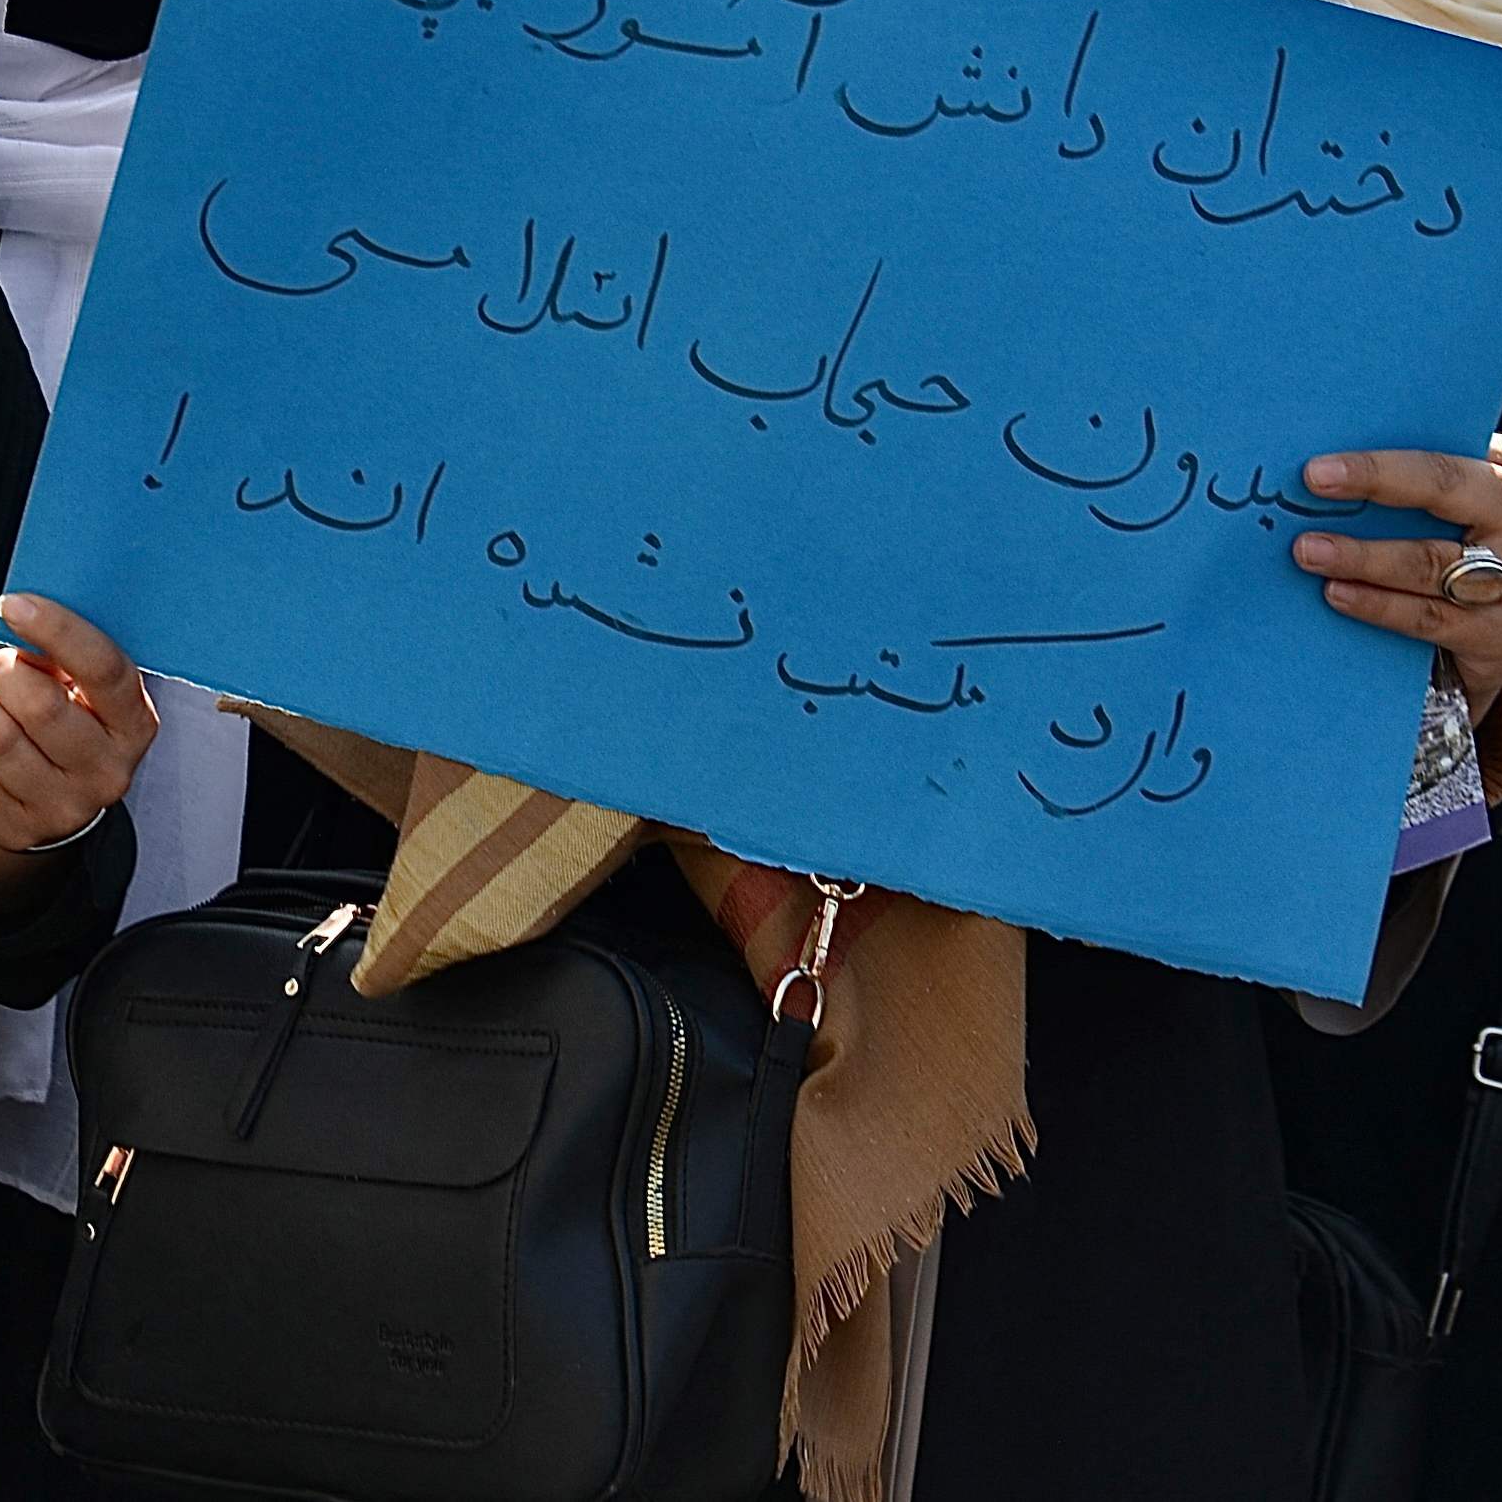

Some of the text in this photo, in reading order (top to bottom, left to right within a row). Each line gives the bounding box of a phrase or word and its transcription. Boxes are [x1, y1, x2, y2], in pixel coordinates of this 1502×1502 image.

[834, 11, 1105, 159] دانش
[1153, 48, 1463, 236] دختران
[690, 258, 971, 445] حجاب
[237, 461, 445, 544] اند
[487, 531, 753, 648] نشده
[777, 623, 1165, 715] مکتب
[1018, 690, 1211, 817] وارد
